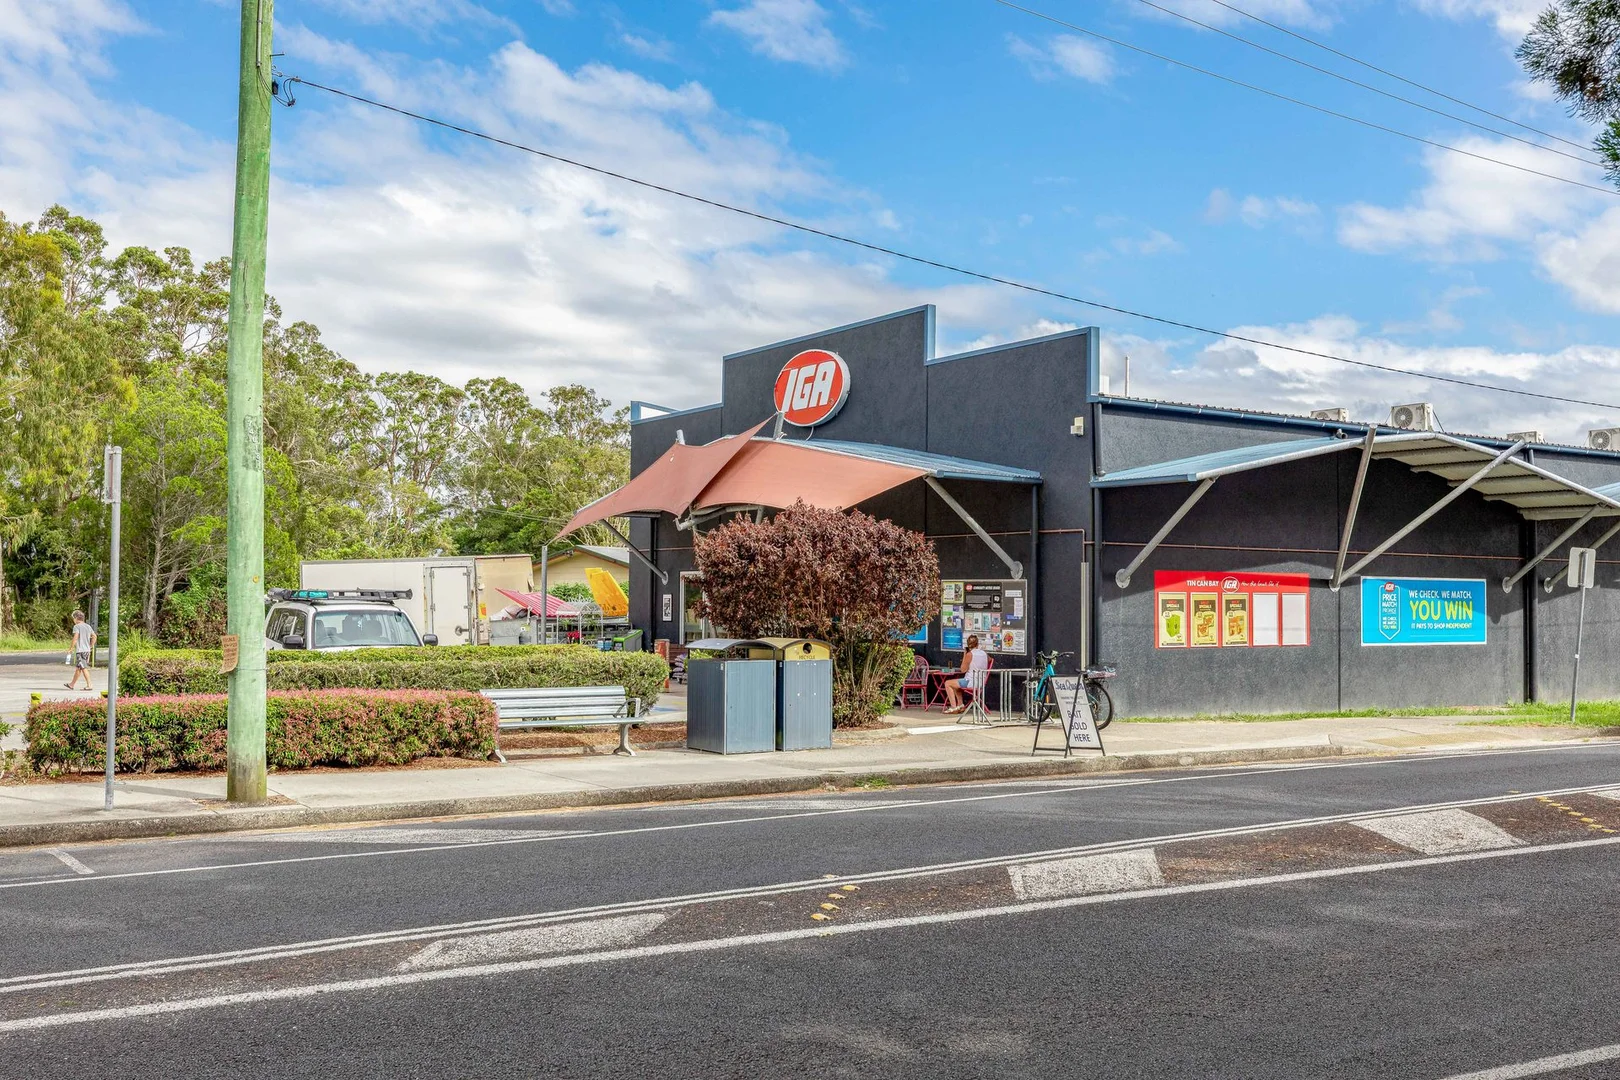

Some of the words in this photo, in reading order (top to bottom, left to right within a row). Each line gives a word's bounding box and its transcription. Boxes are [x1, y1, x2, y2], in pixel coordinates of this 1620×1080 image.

[780, 360, 836, 413] IGA
[1223, 579, 1238, 589] IGA
[1382, 593, 1397, 602] PRICE
[1409, 590, 1418, 598] WE
[1441, 590, 1450, 599] WE
[1409, 600, 1441, 621] YOU
[1445, 600, 1473, 620] WIN
[1074, 733, 1091, 742] HERE
